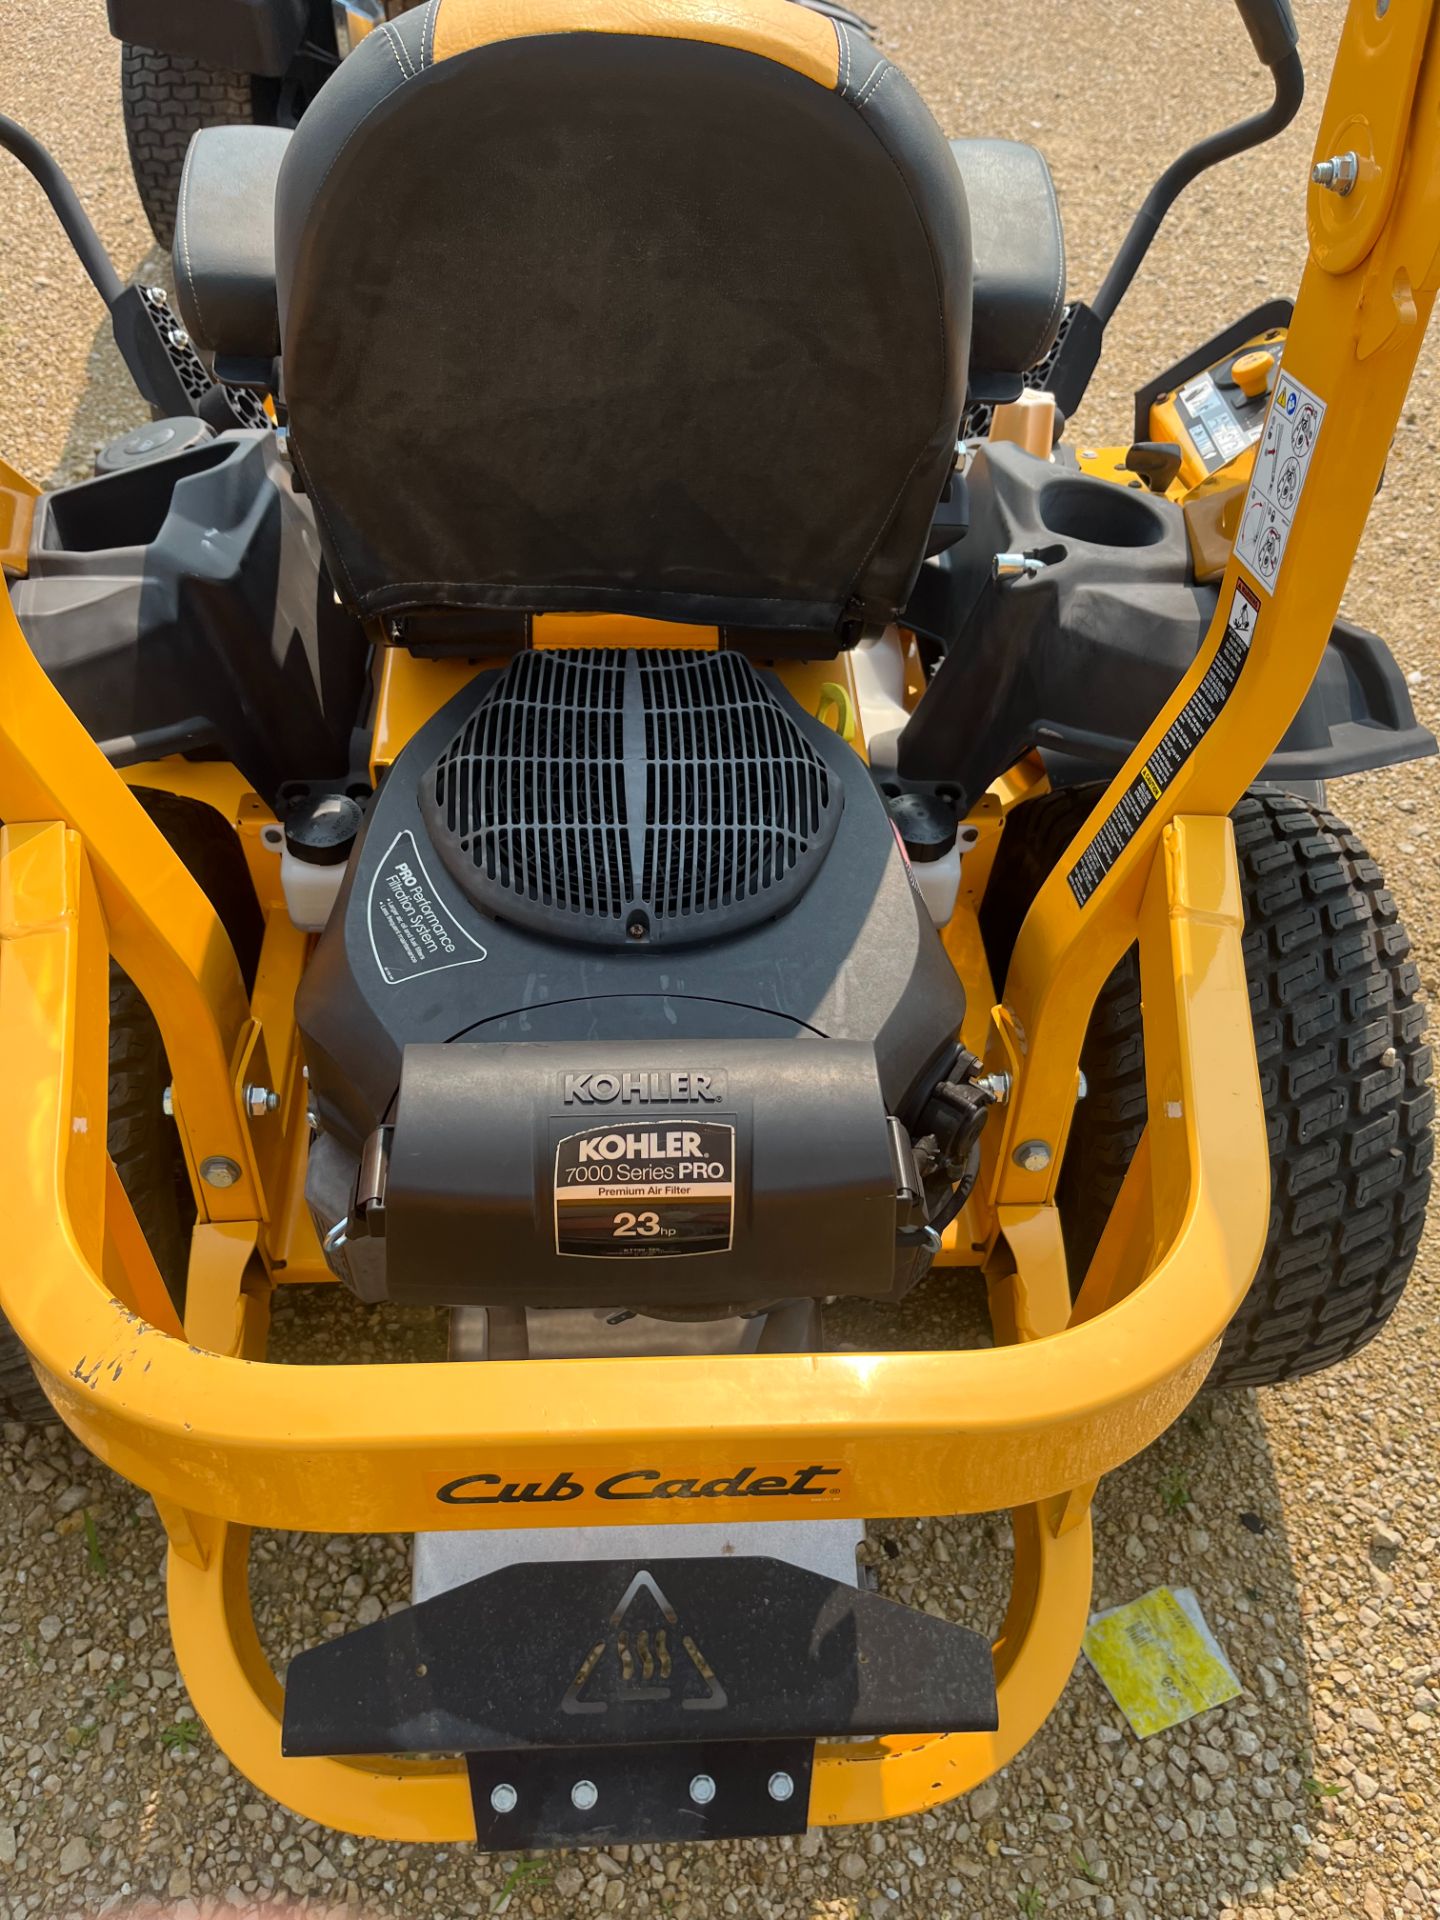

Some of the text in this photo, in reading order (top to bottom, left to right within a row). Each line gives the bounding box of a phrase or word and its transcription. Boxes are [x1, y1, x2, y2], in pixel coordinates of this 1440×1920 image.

[386, 875, 438, 953] Filtration System
[395, 862, 456, 953] PRO Performance
[566, 1162, 724, 1182] 7000 Series PRO
[598, 1186, 690, 1196] Premium Air Filter
[436, 1465, 842, 1504] Cub Cadet
